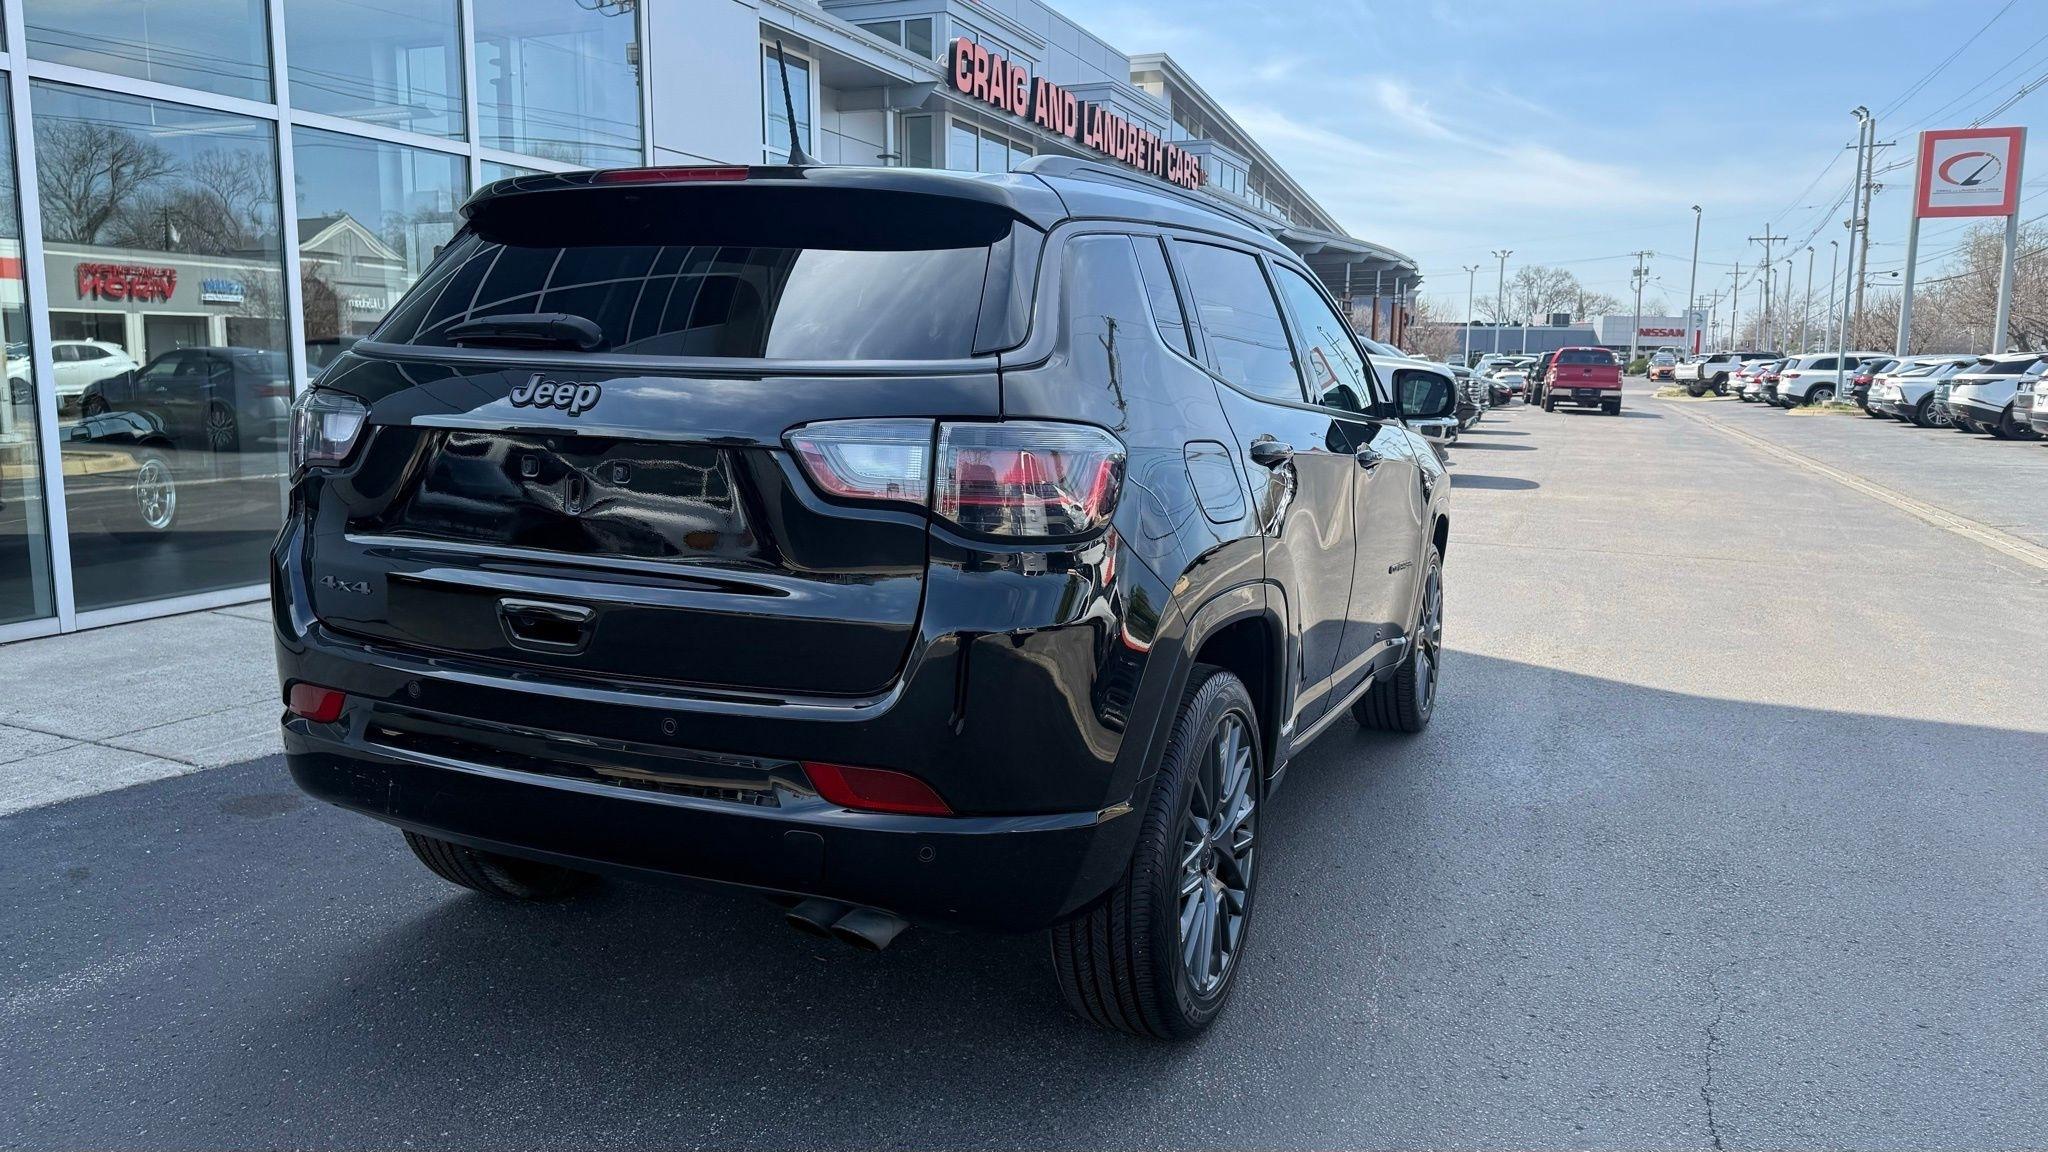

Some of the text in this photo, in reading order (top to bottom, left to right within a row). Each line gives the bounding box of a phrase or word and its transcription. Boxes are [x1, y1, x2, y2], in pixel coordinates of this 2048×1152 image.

[953, 37, 1029, 117] CRAIG
[1034, 77, 1078, 138] AND
[1083, 101, 1163, 176] LANDRETH
[1167, 143, 1199, 190] CARS
[1638, 327, 1686, 338] NISSAN
[510, 373, 601, 417] Jeep
[319, 575, 372, 595] 4x4
